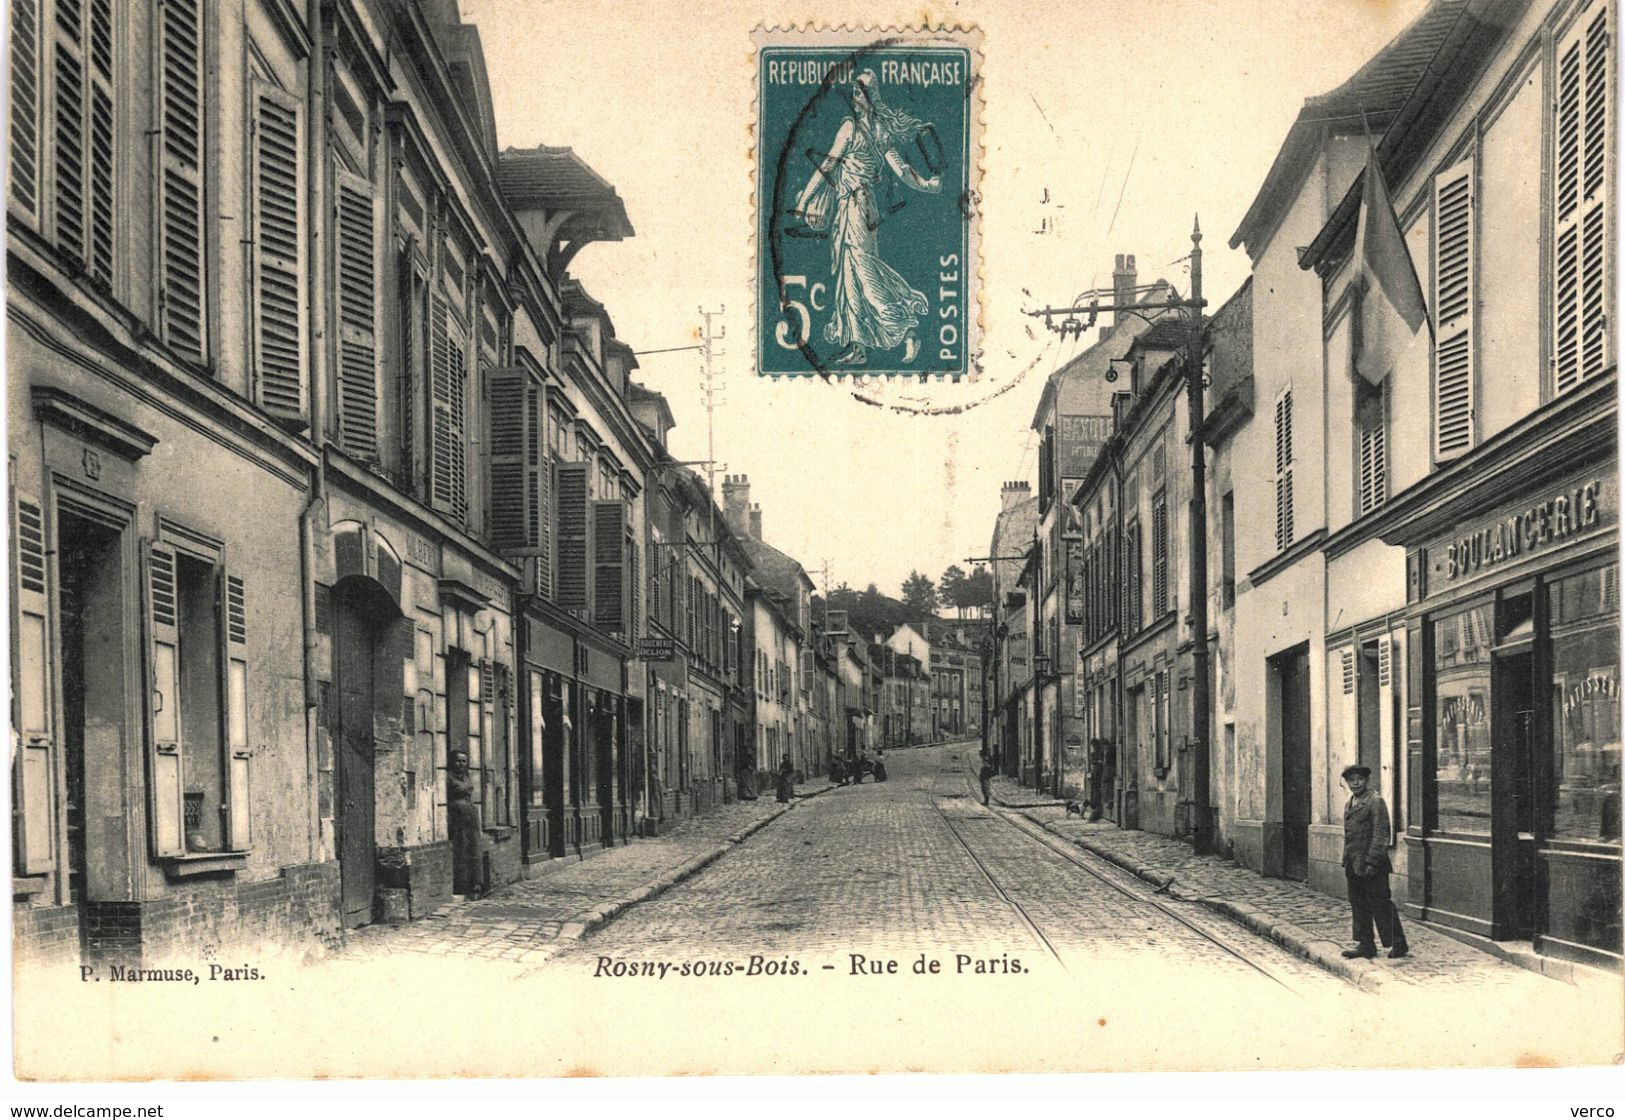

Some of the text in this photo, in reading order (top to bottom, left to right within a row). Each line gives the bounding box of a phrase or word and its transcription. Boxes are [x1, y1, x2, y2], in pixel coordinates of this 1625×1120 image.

[881, 61, 961, 88] FRANÇAISE
[940, 253, 958, 360] POSTES
[1447, 480, 1600, 581] BOULANGERIE
